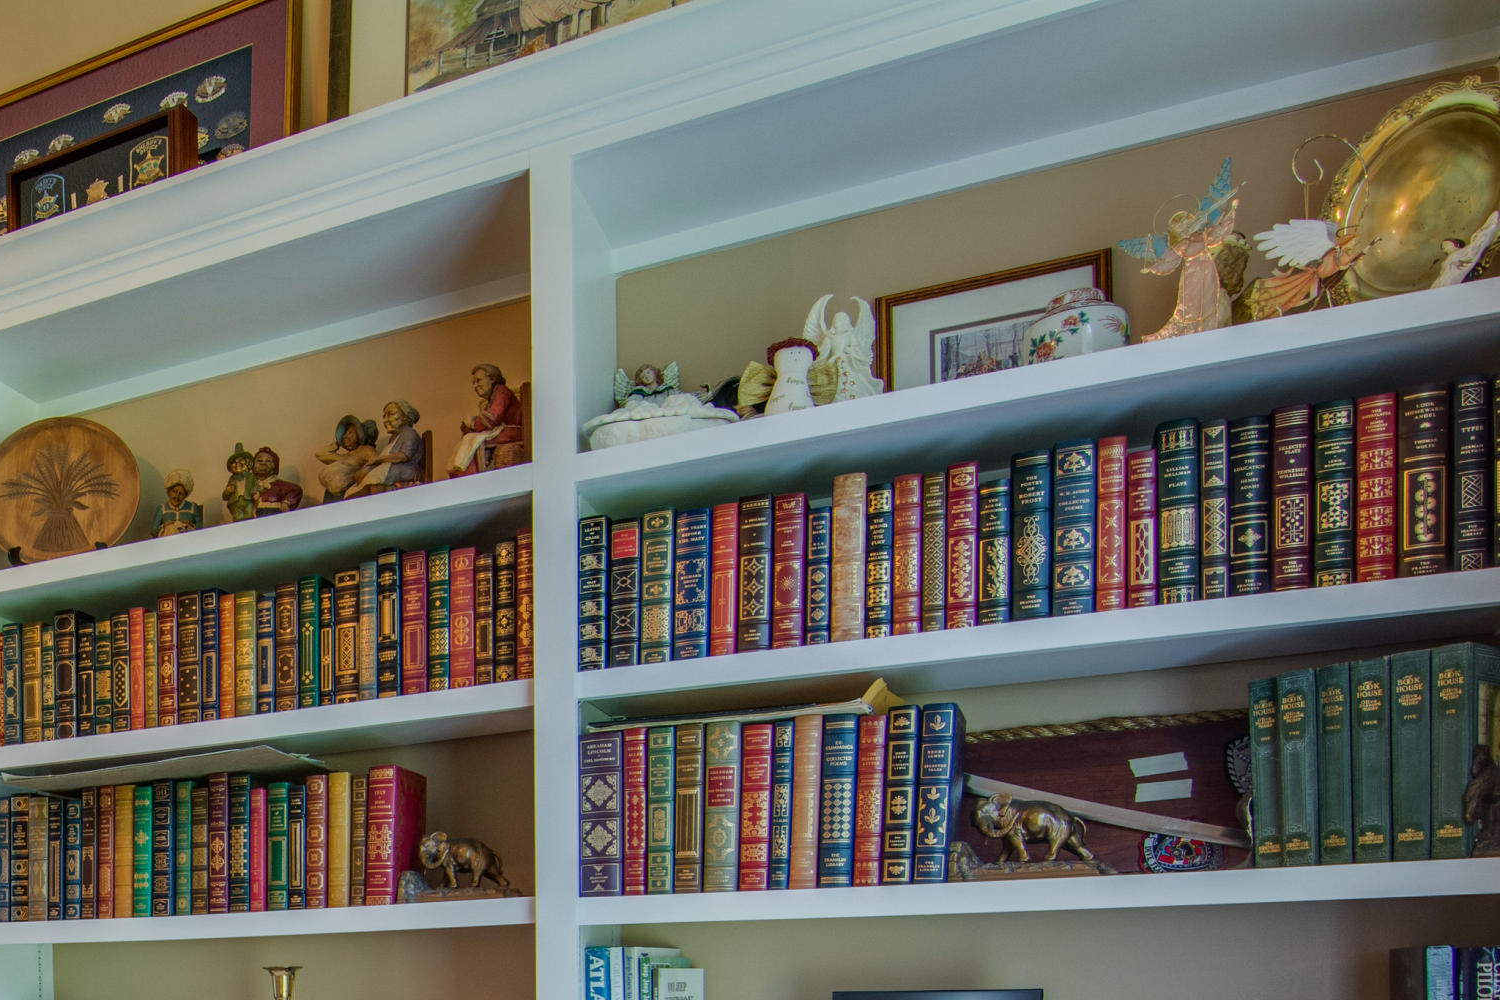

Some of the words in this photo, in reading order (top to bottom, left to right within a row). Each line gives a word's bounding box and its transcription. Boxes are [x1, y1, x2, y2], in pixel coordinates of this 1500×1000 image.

[1019, 491, 1045, 499] ROBERT
[1439, 670, 1461, 680] BOOK
[1397, 677, 1420, 685] BOOK
[1438, 677, 1464, 687] HOUSE
[1358, 683, 1380, 692] BOOK
[1396, 683, 1424, 693] HOUSE
[1357, 689, 1383, 698] HOUSE
[1282, 694, 1303, 704] BOOK
[1281, 701, 1305, 711] HOUSE
[643, 963, 651, 977] Jeep
[643, 979, 651, 992] Jeep
